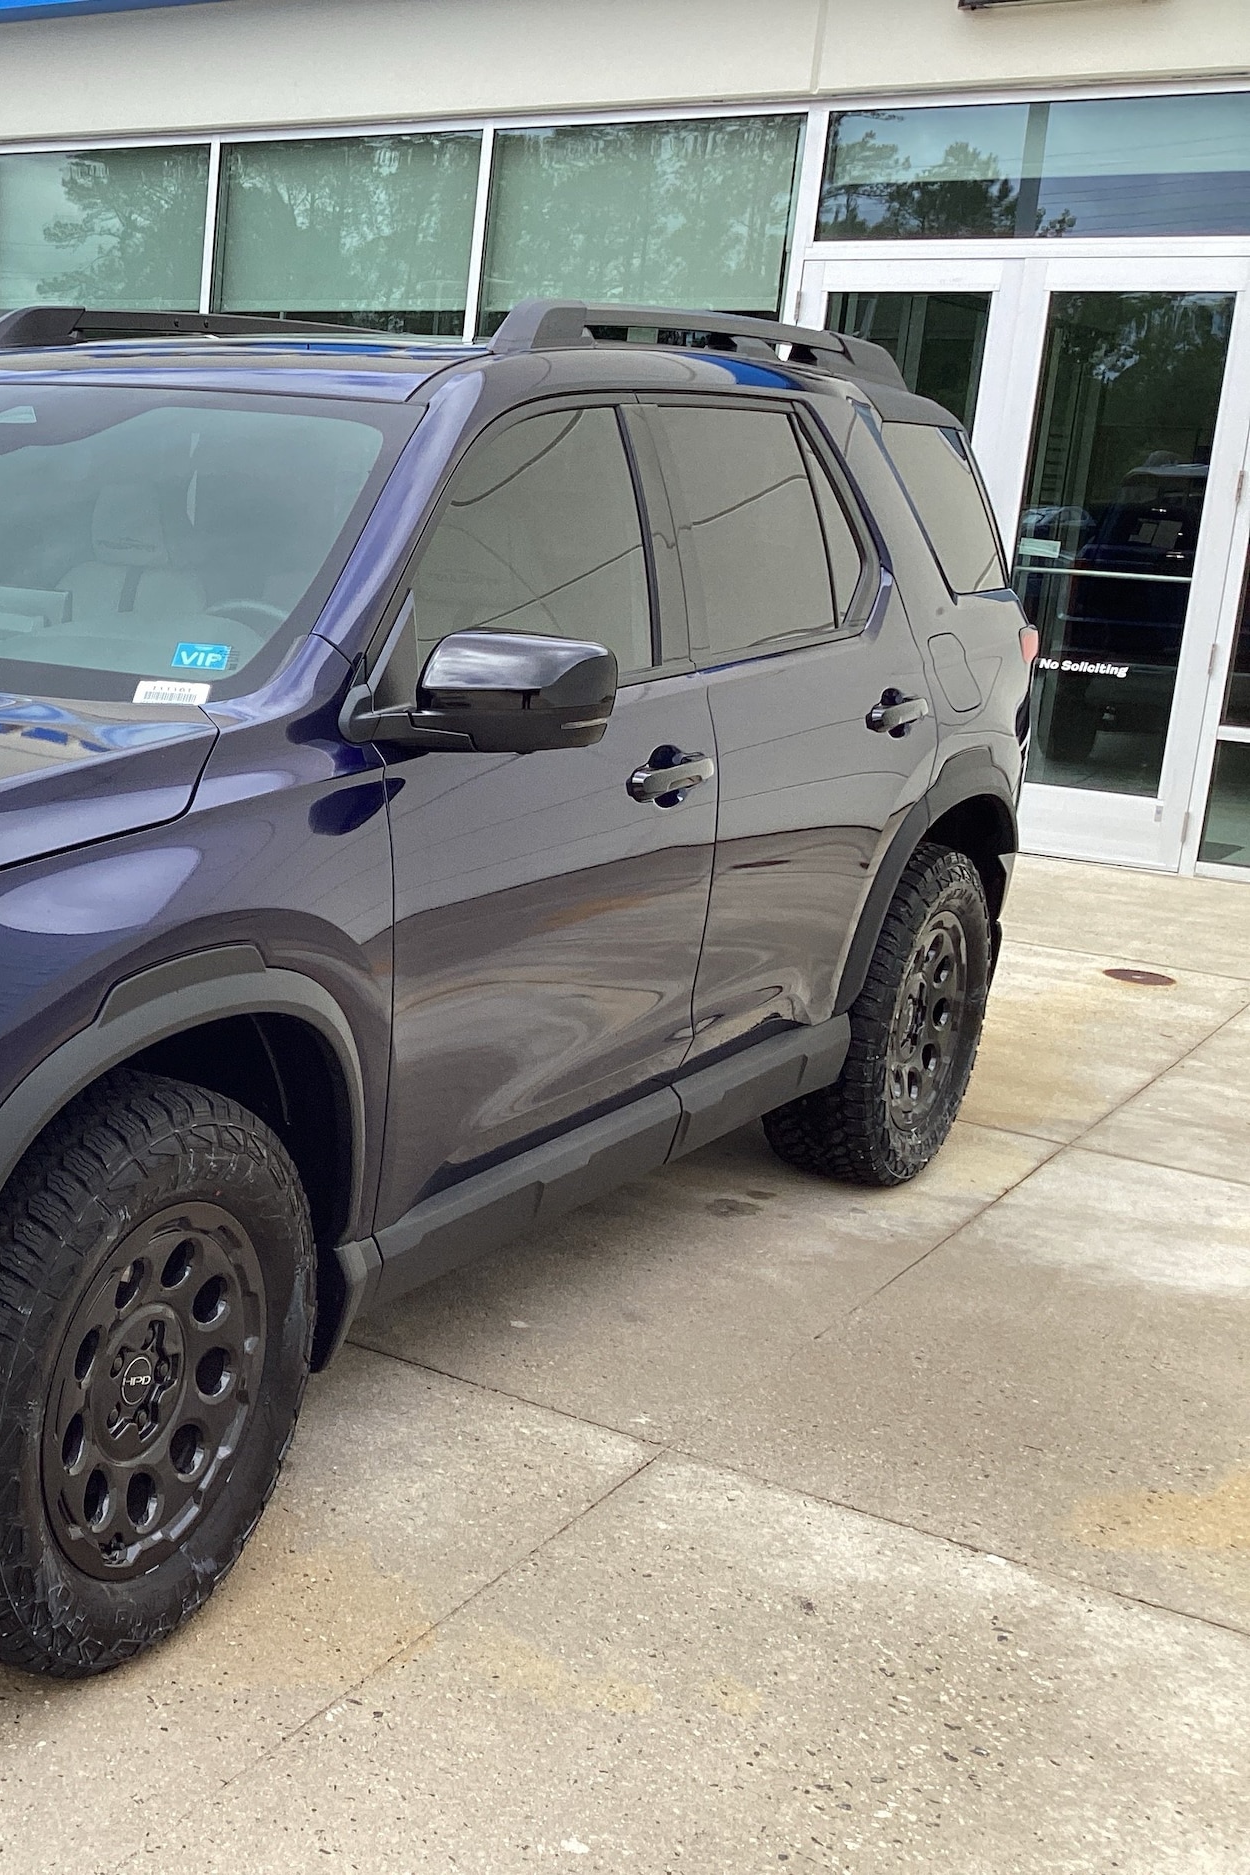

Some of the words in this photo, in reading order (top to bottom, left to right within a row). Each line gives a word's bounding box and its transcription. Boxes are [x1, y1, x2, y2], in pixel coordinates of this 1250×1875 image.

[180, 650, 222, 667] VIP
[1038, 658, 1059, 670] No
[1061, 660, 1129, 678] Soliciting
[123, 1375, 152, 1386] HPD
